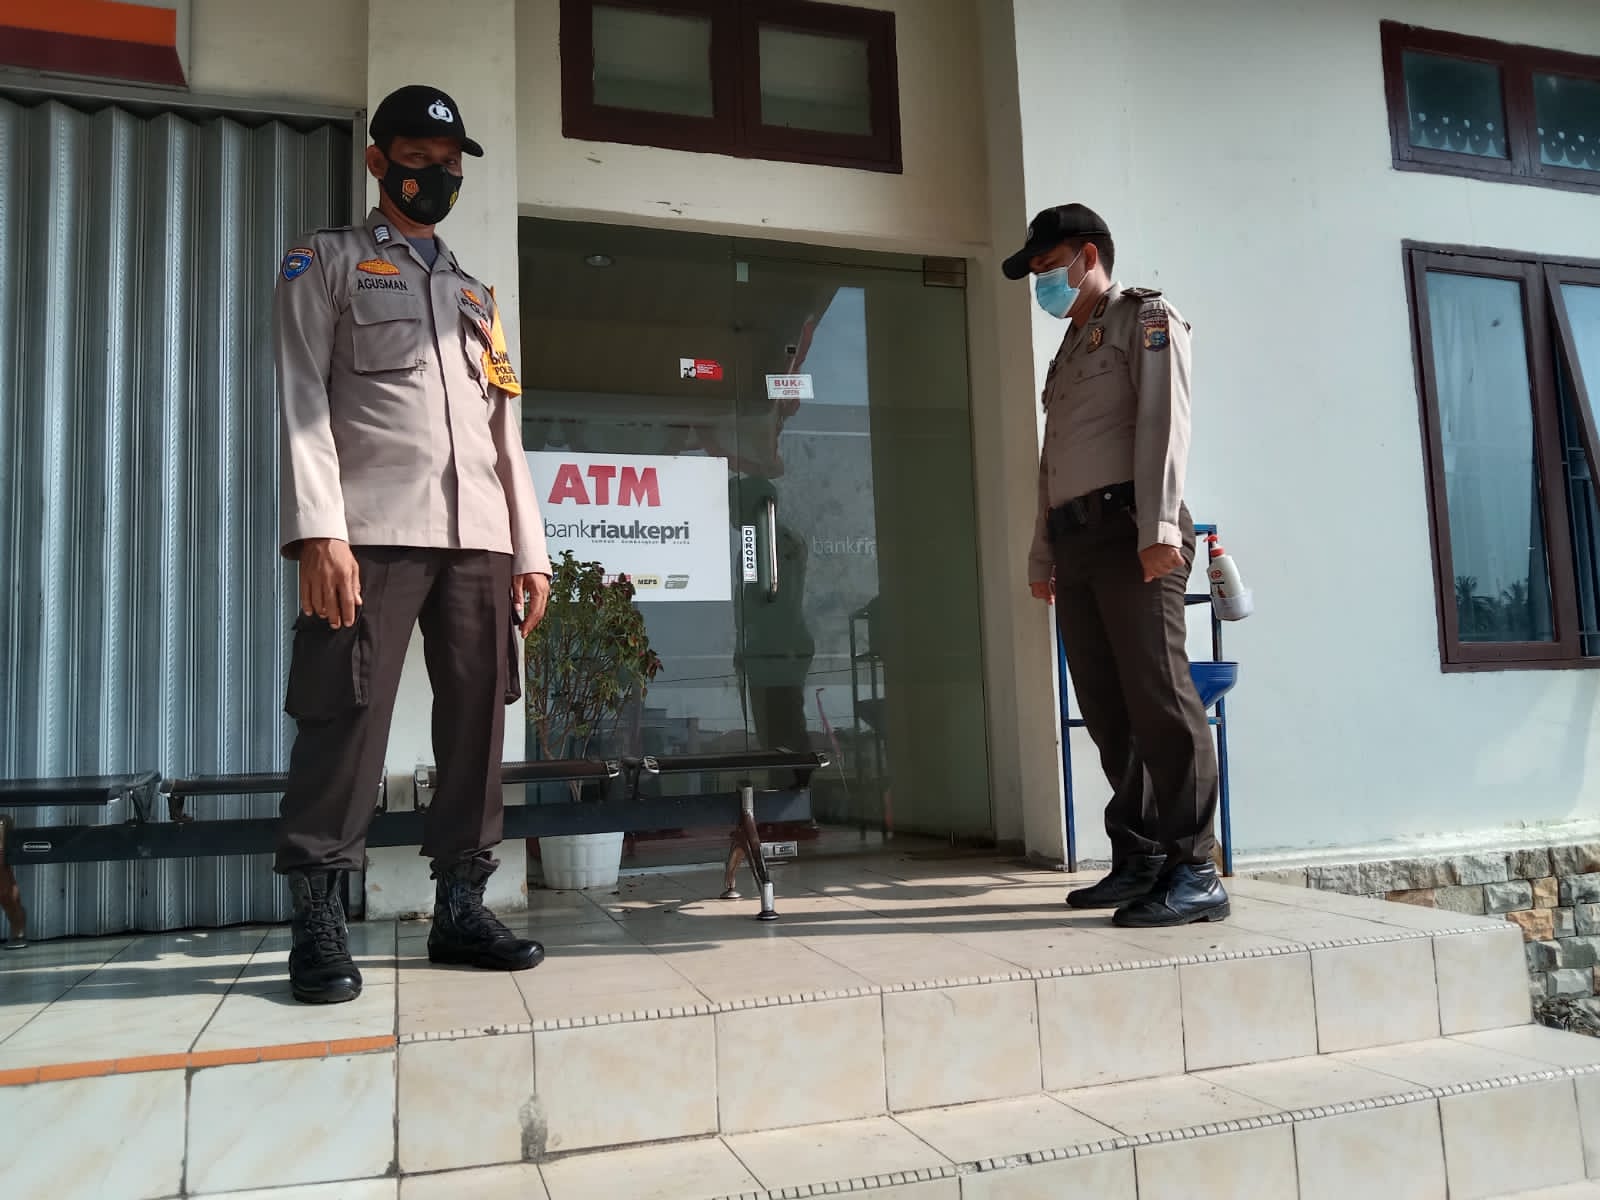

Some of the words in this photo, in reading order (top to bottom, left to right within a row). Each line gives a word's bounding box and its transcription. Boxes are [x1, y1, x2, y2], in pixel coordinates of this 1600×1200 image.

[357, 279, 408, 291] AGUSMAN
[548, 464, 661, 507] ATM
[544, 518, 690, 544] bankriaukepri
[745, 529, 754, 569] DORONG
